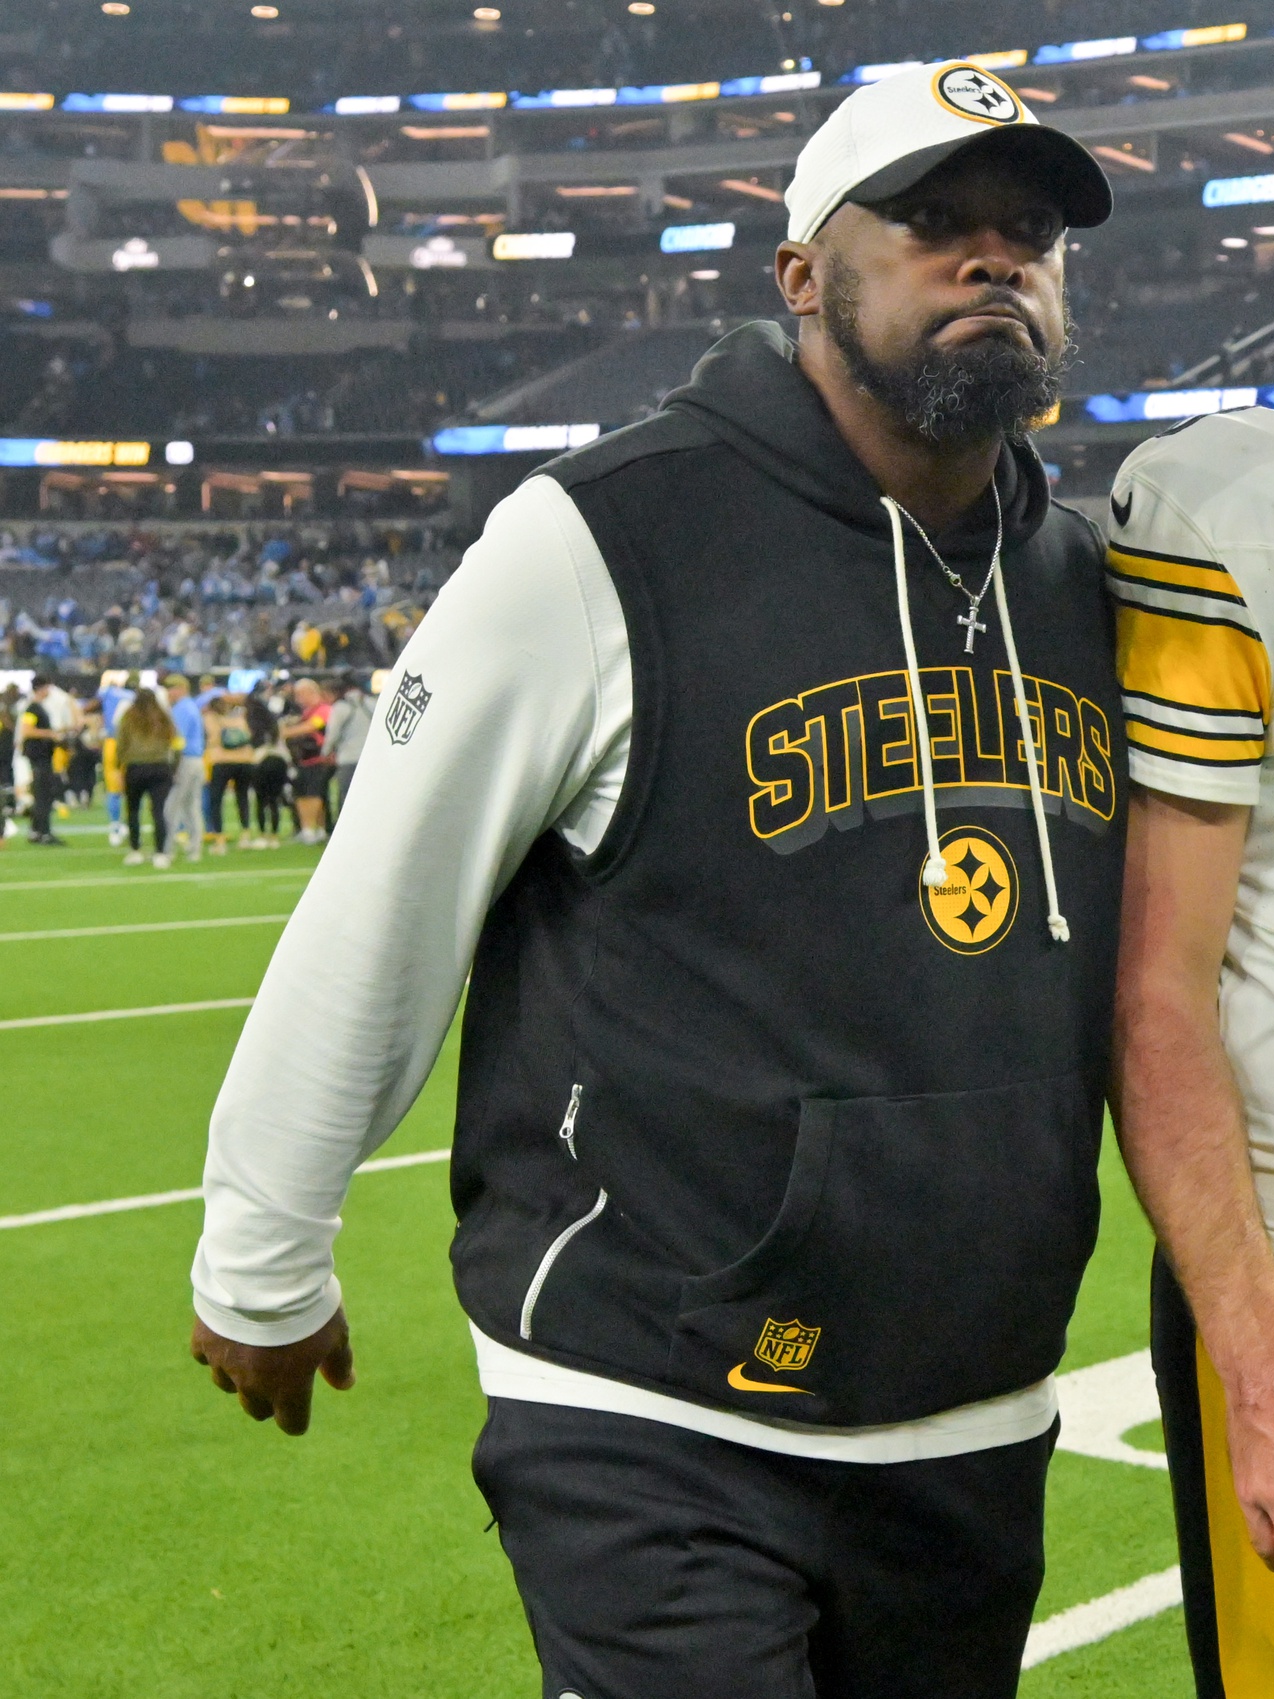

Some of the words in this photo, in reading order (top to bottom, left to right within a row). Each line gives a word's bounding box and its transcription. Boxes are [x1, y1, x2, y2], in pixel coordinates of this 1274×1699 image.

[388, 696, 417, 740] NFL
[745, 666, 1117, 839] STEELERS
[933, 884, 967, 896] Steelers
[762, 1339, 803, 1364] NFL
